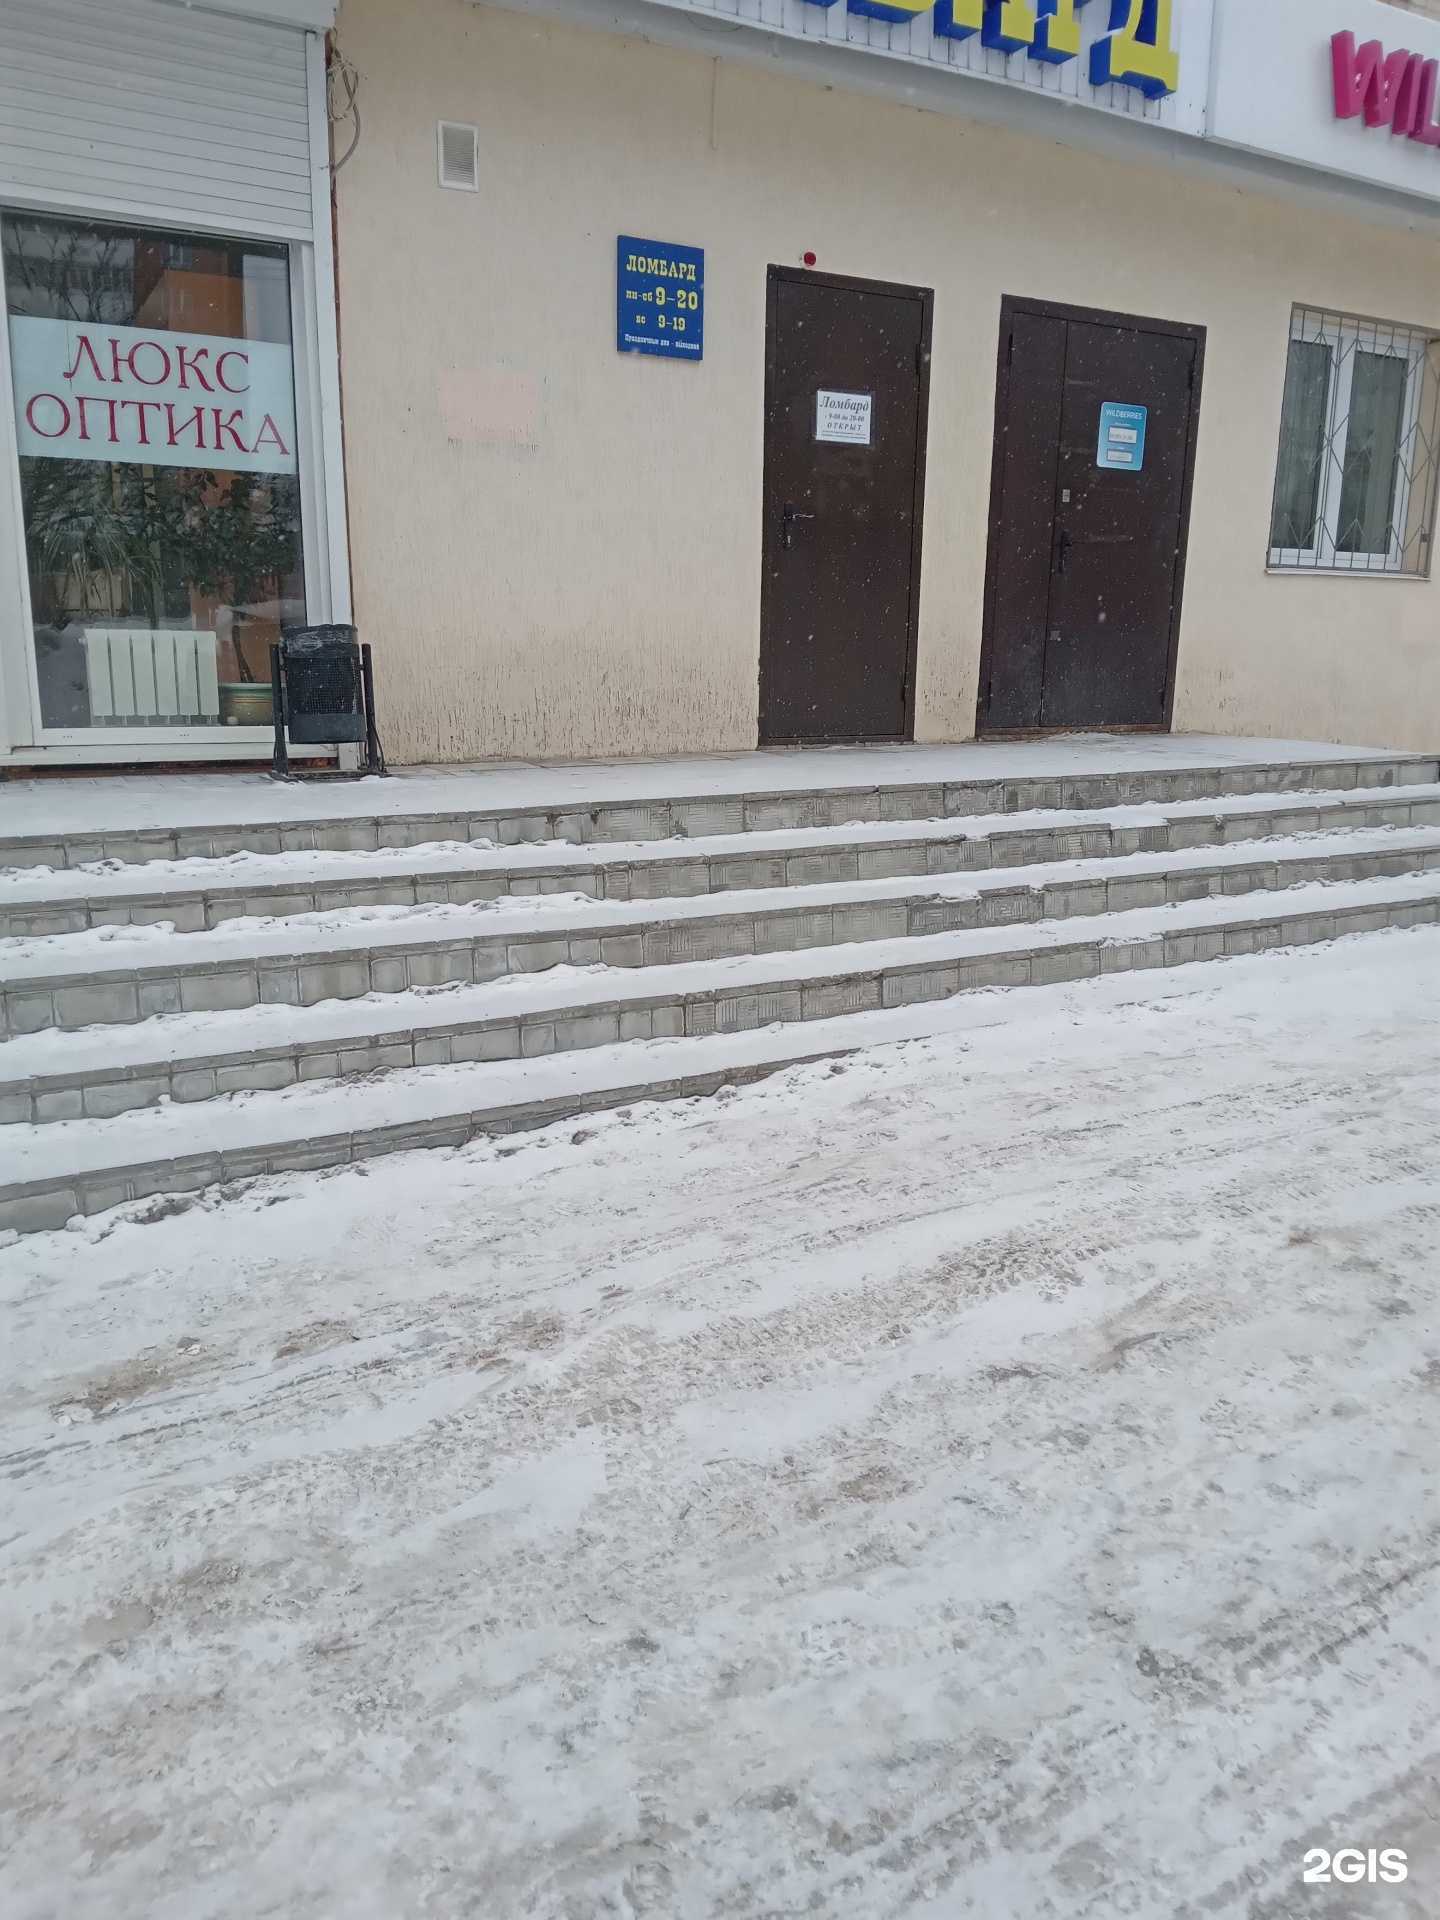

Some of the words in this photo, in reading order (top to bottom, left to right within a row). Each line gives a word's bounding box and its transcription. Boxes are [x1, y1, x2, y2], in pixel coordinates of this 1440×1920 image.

[626, 255, 696, 281] ЛОМБАРД
[62, 335, 251, 394] ЛЮКС
[26, 393, 290, 456] ОПТИКА
[819, 396, 869, 414] Ломбард
